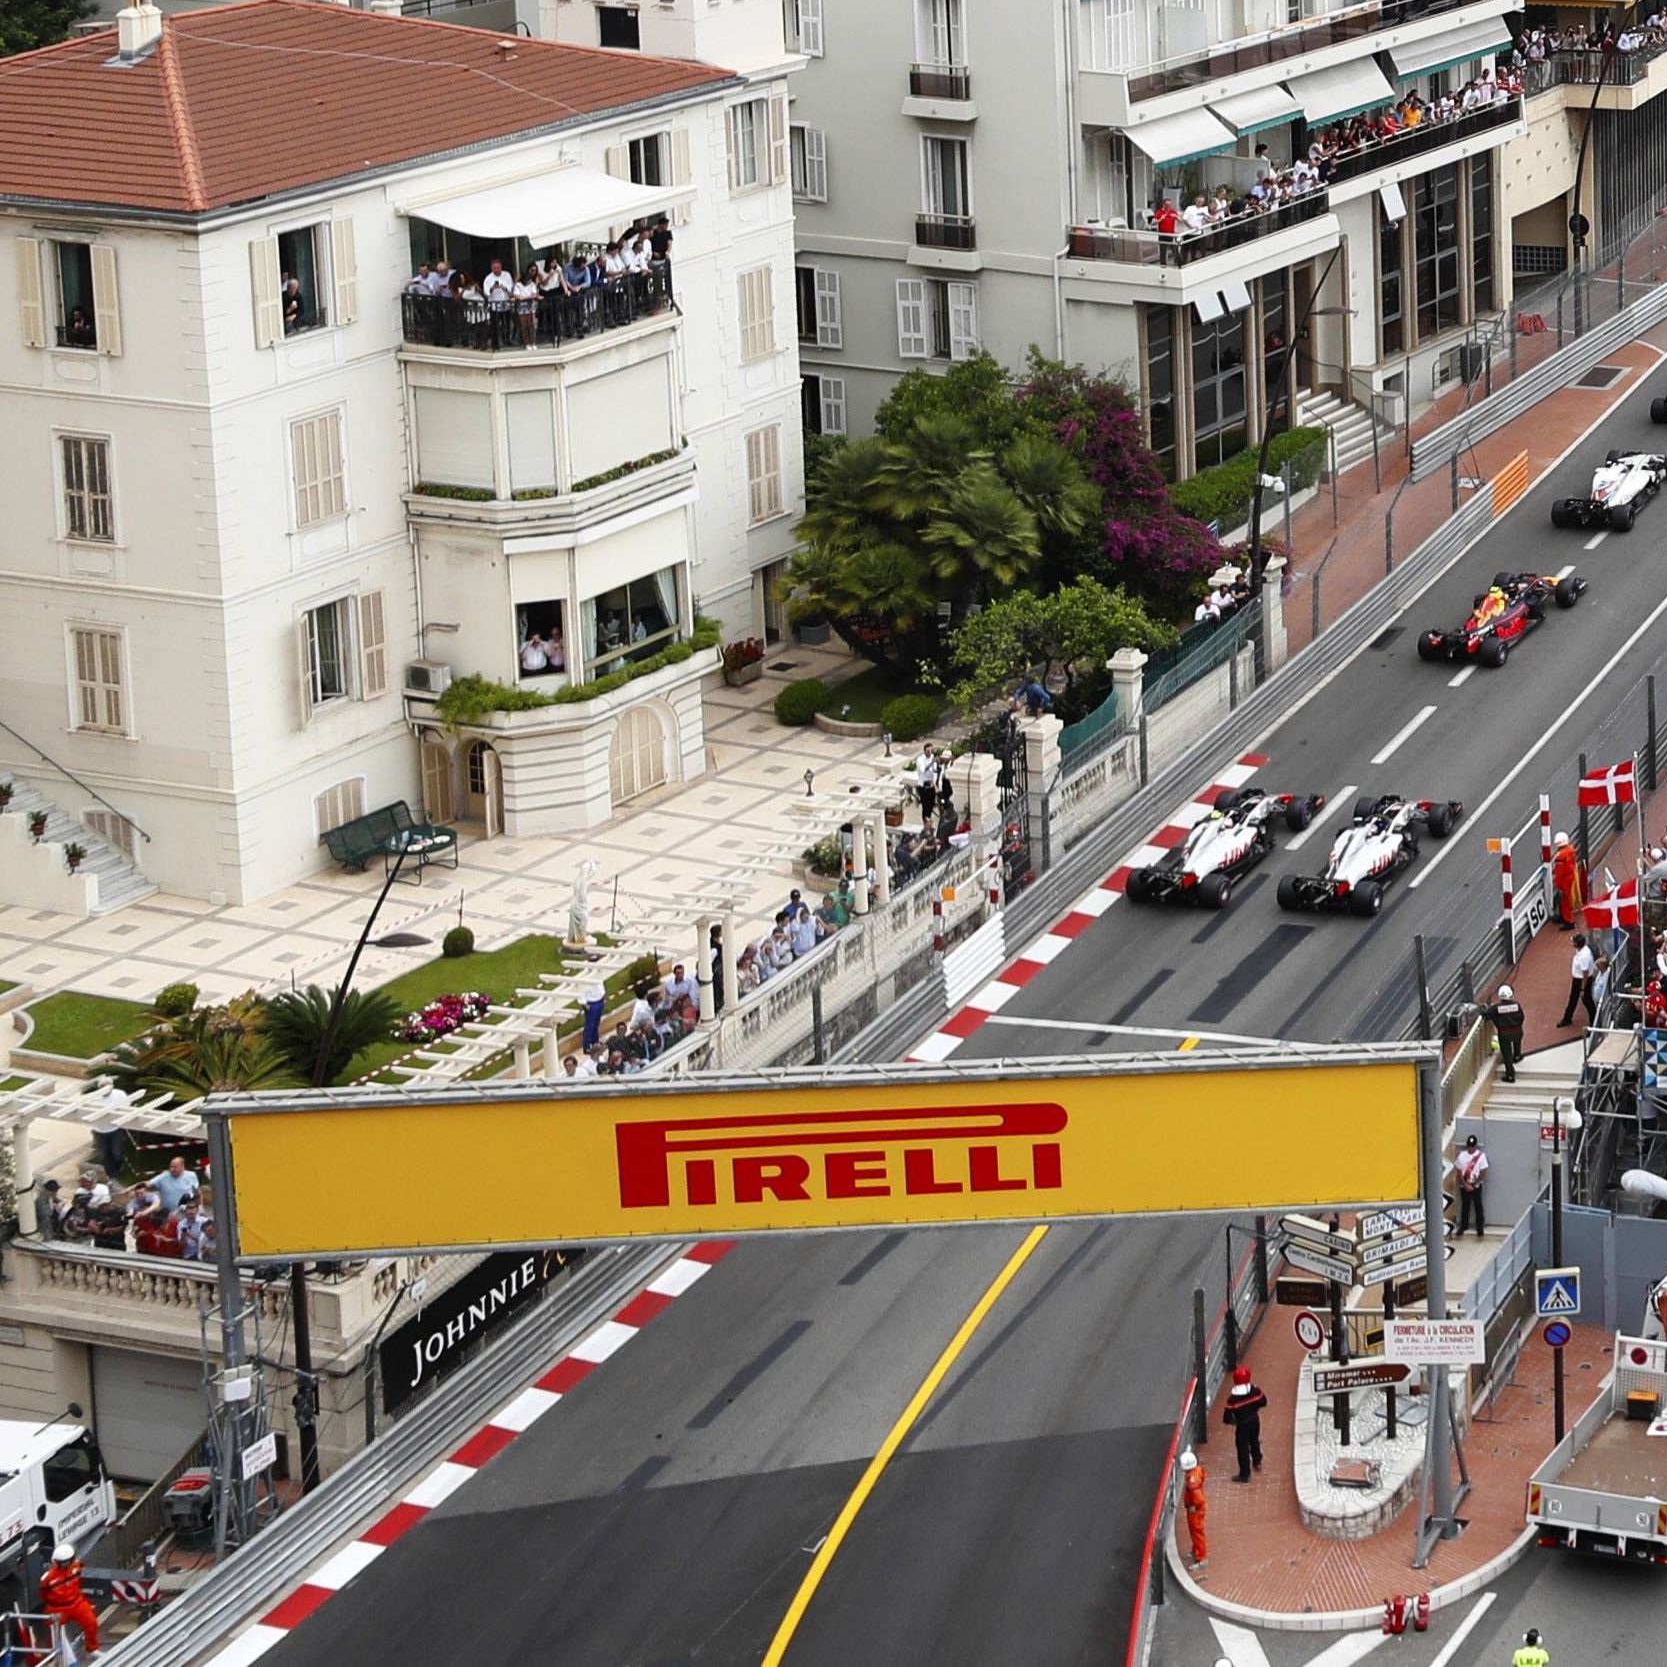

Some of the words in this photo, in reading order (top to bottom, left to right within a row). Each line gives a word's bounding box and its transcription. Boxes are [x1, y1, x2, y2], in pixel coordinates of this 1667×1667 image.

[1530, 903, 1545, 930] SC
[616, 1102, 1068, 1208] PIRELLI
[1323, 1235, 1350, 1251] CASINO
[1365, 1238, 1409, 1259] GRIMALDI
[1367, 1265, 1408, 1283] Auditorium
[411, 1257, 536, 1387] JOHNNIE
[1439, 1325, 1475, 1335] CIRCULATION
[1327, 1370, 1361, 1380] Miramar
[1327, 1379, 1345, 1389] Port
[1347, 1377, 1374, 1387] Palace
